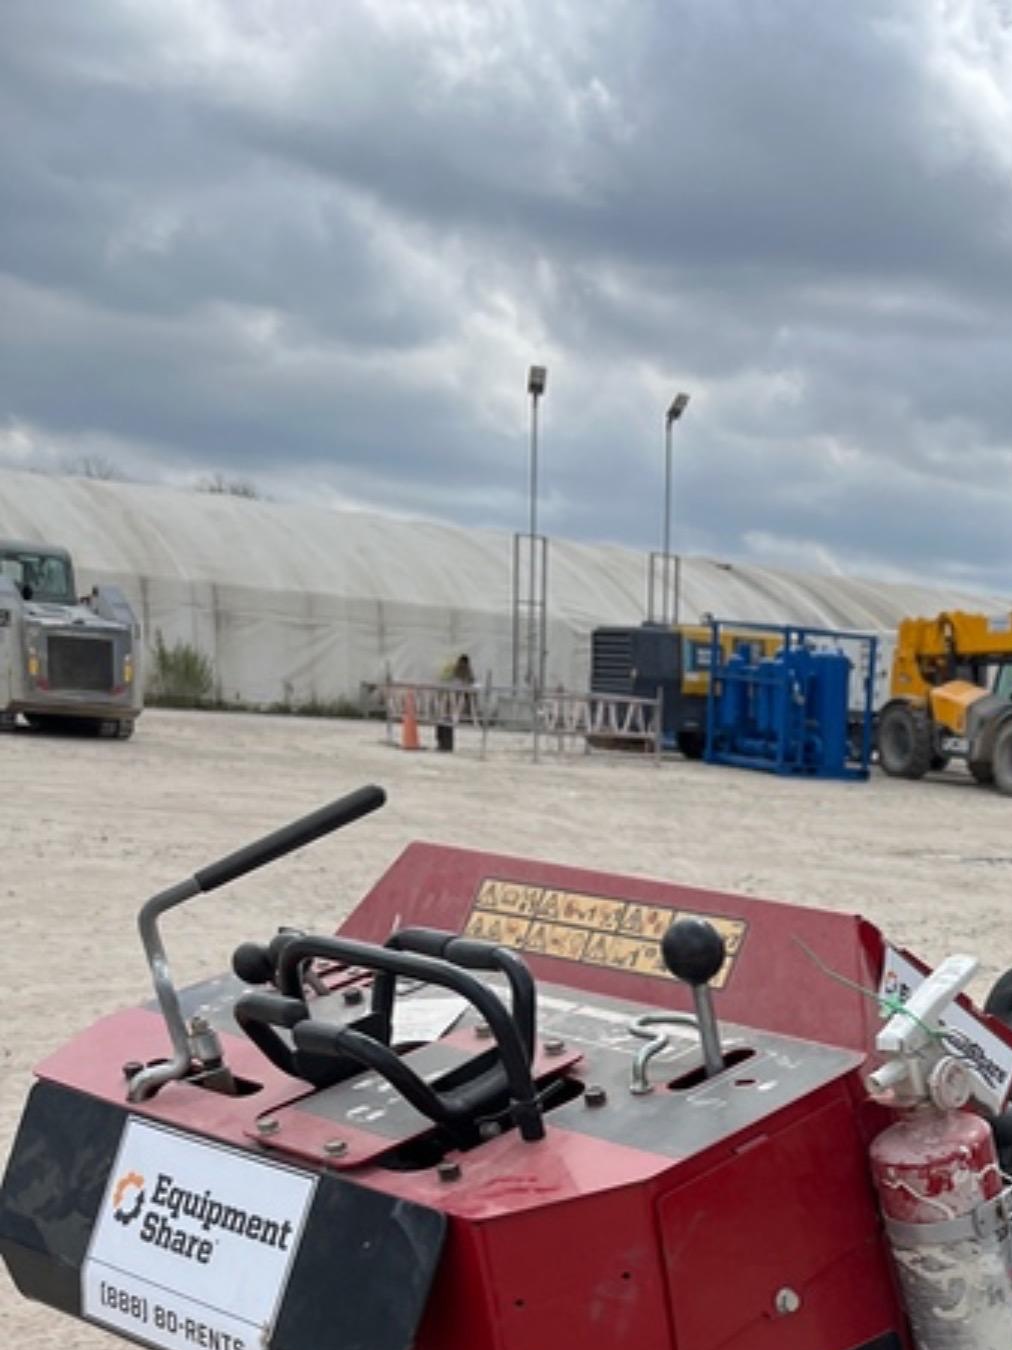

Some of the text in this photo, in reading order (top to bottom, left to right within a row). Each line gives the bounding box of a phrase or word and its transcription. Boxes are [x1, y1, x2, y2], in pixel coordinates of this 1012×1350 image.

[151, 1174, 292, 1251] Equipment
[140, 1213, 214, 1264] Share
[100, 1280, 149, 1325] (888)
